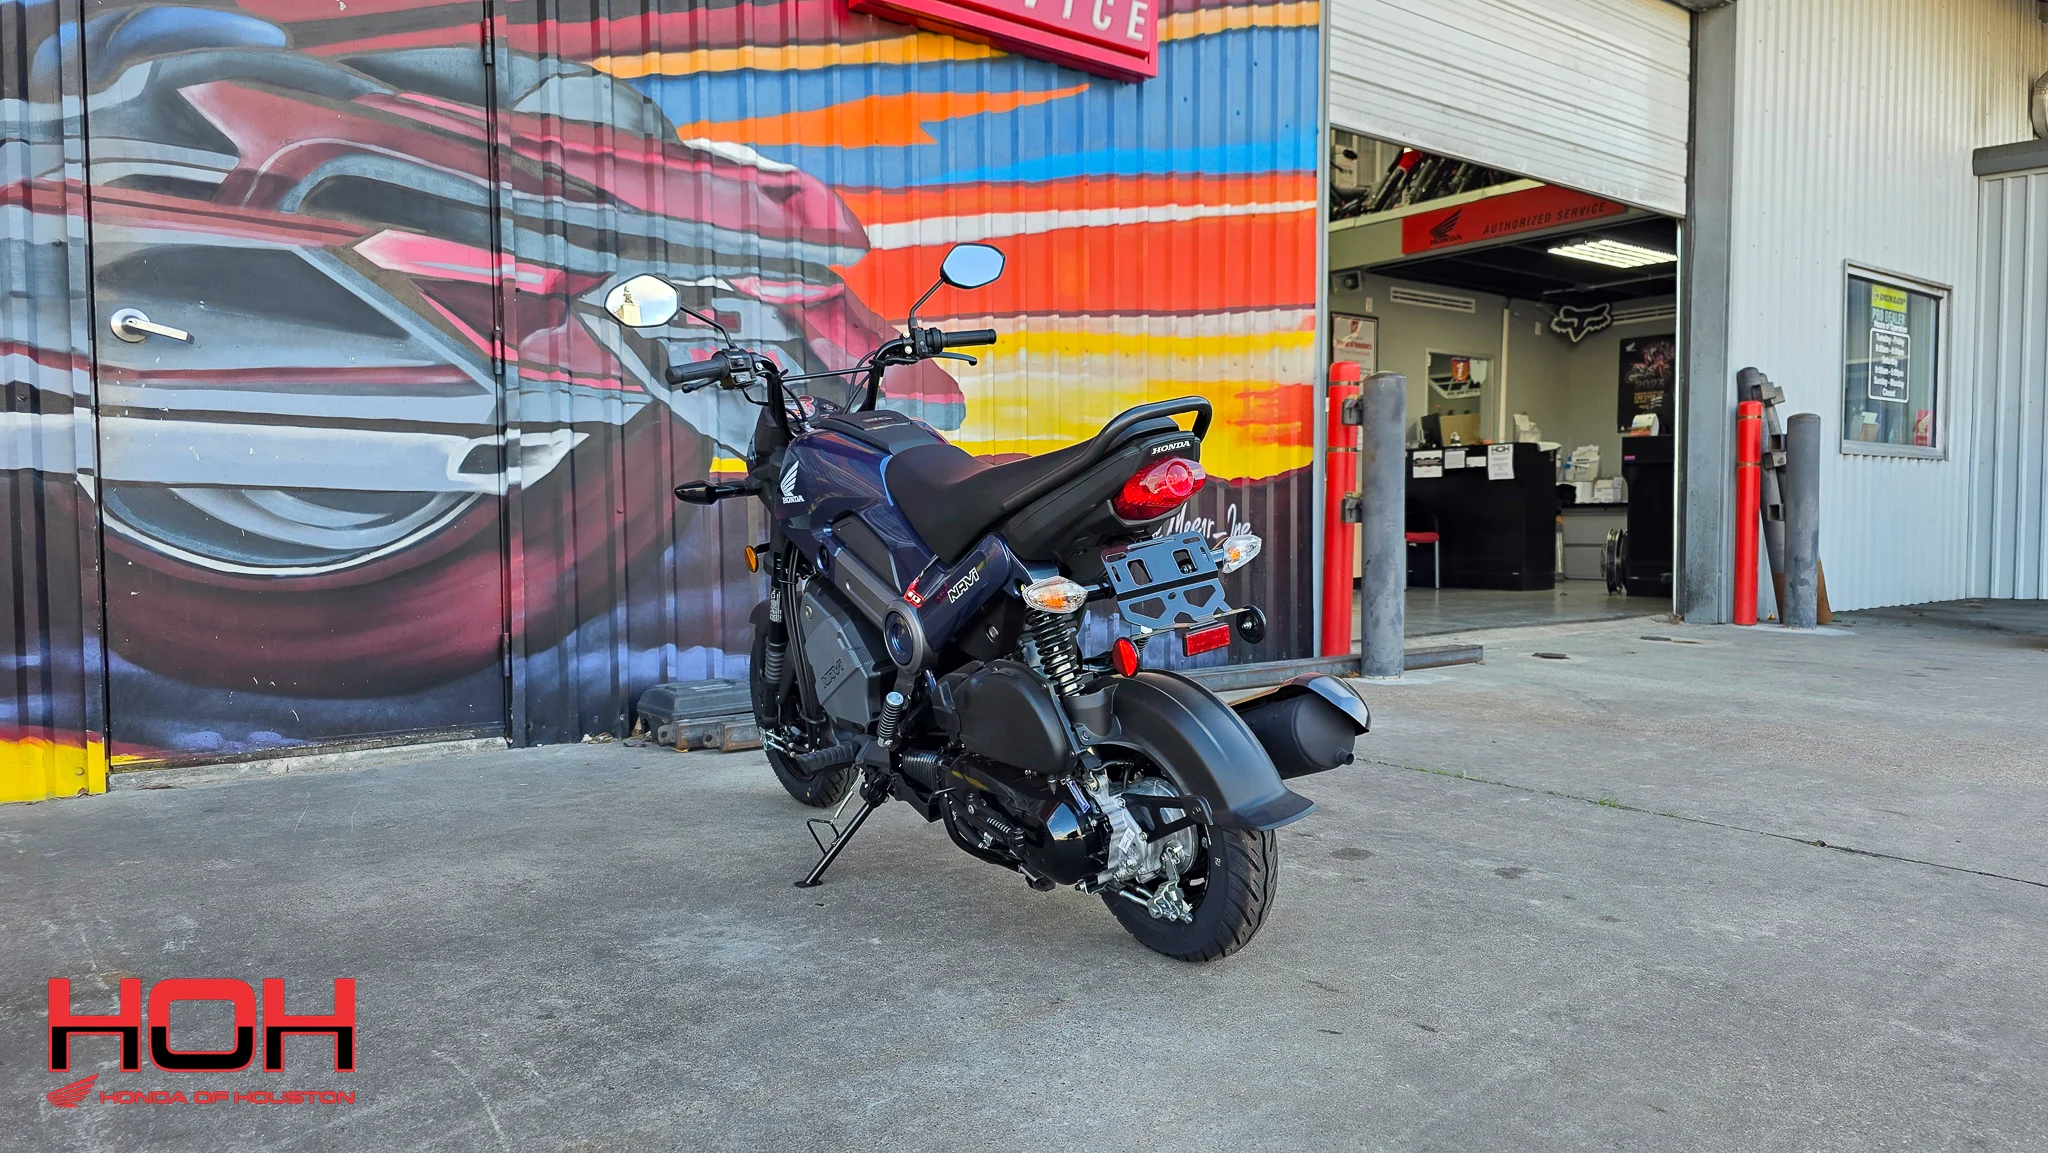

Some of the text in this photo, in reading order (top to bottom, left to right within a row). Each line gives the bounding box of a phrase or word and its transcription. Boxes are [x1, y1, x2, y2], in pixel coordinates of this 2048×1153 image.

[1483, 202, 1606, 235] AUTHORIZED SERVICE
[1430, 234, 1463, 246] HONDA
[1880, 293, 1906, 306] DUNLOP
[1872, 308, 1906, 327] PRO DEALER
[1151, 440, 1191, 455] HONDA
[782, 494, 805, 504] HONDA
